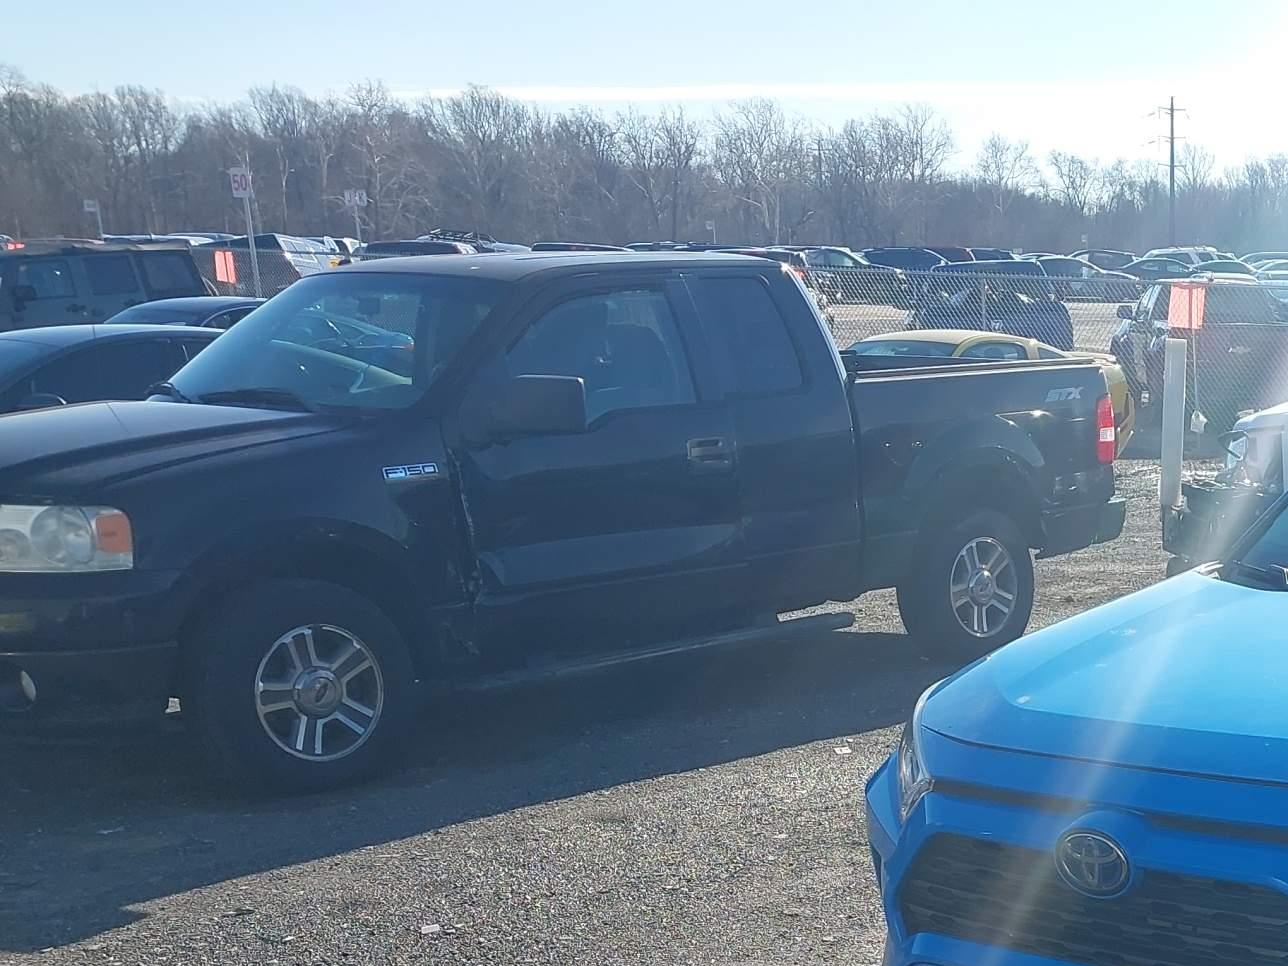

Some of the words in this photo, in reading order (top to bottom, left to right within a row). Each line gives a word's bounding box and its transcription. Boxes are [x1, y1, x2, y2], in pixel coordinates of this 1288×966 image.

[232, 174, 248, 191] 50
[1045, 387, 1084, 402] STX
[383, 463, 438, 479] F-150
